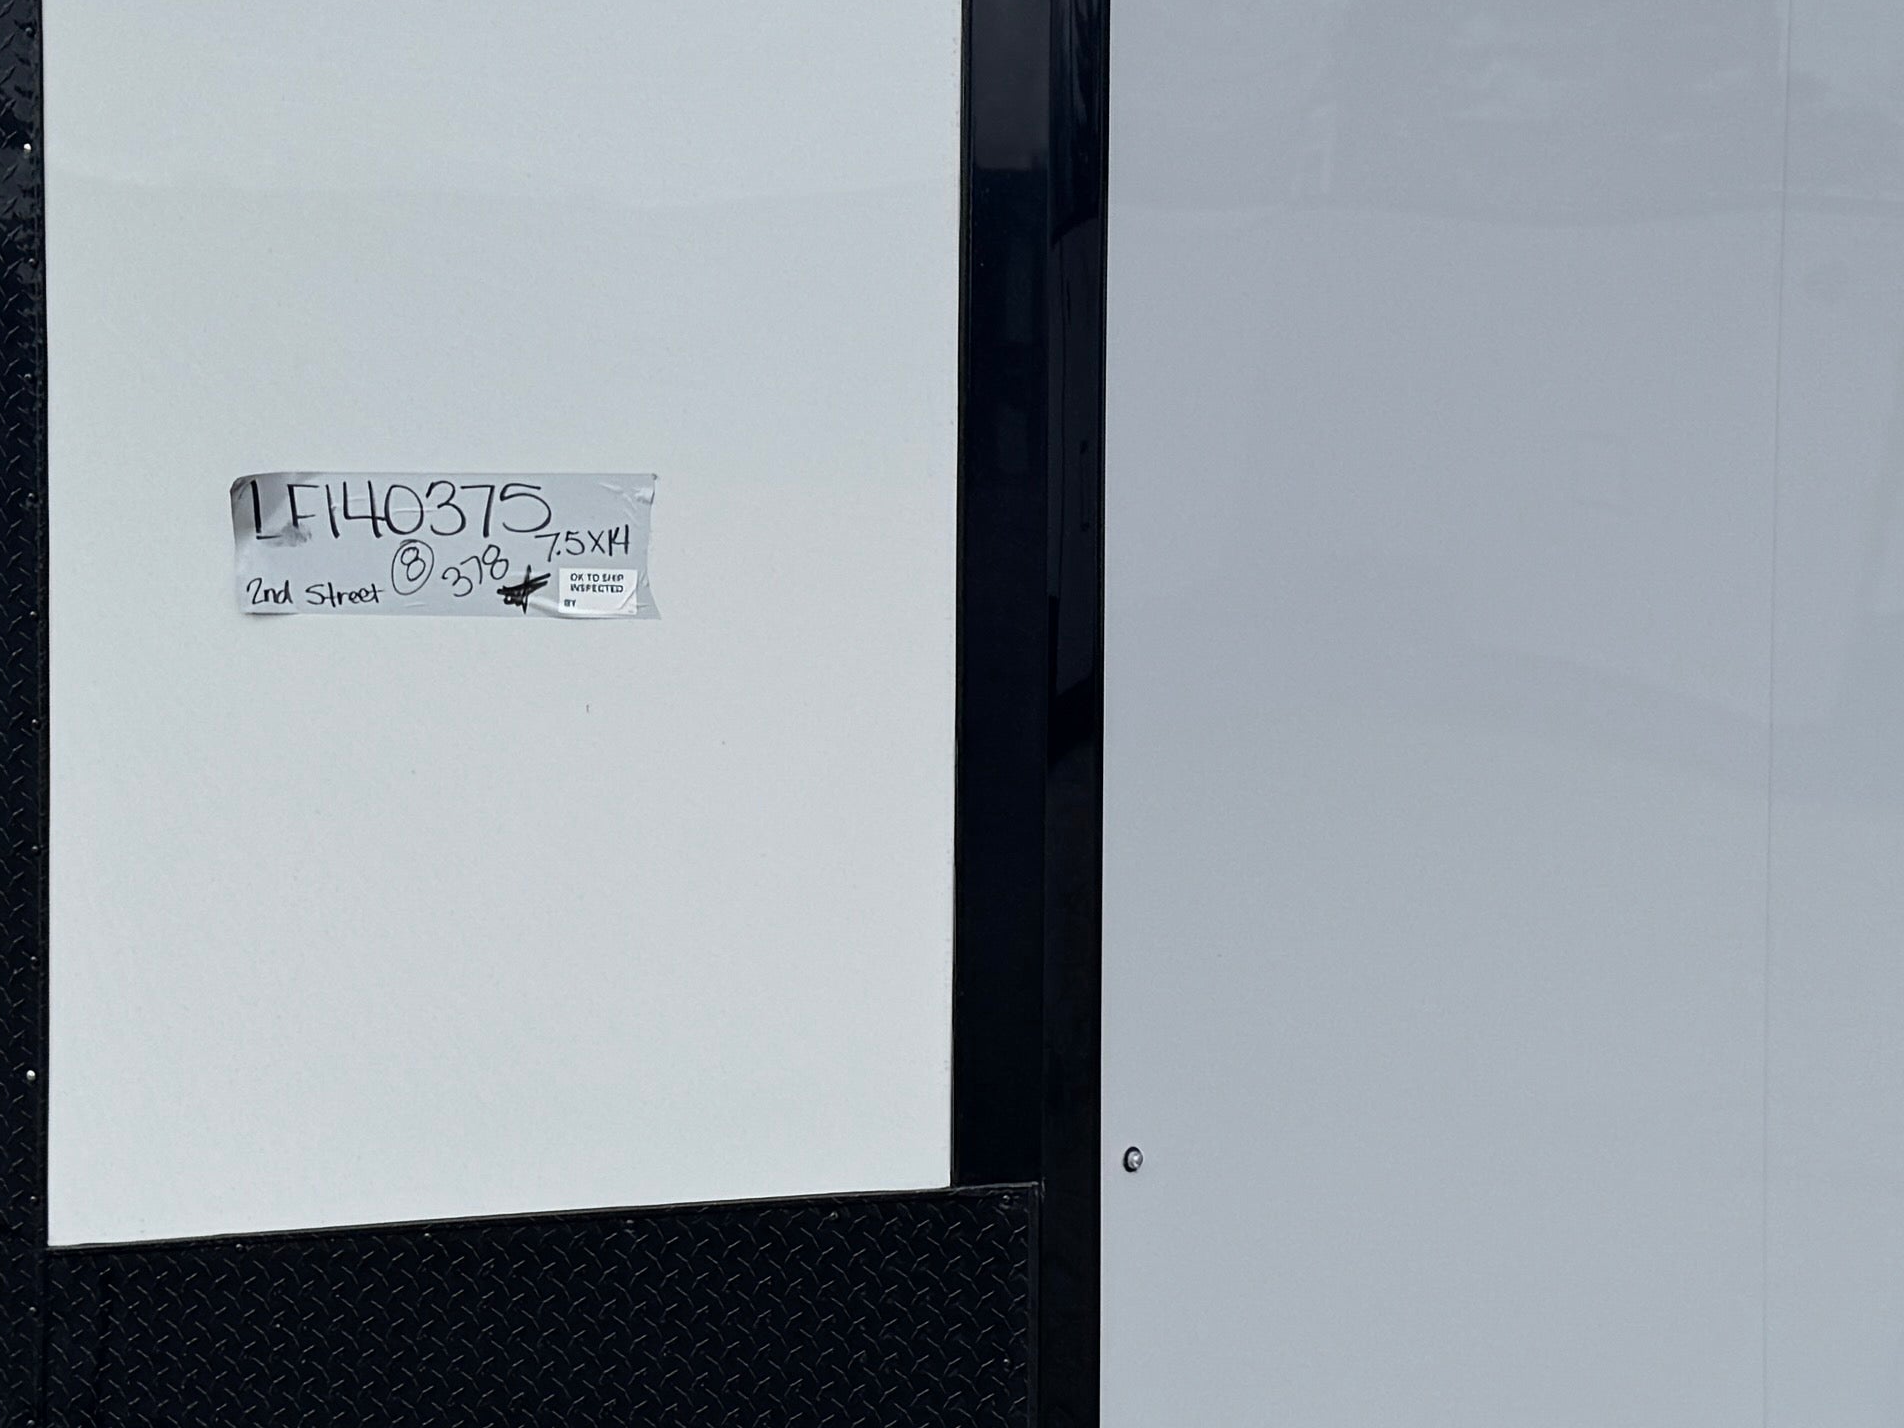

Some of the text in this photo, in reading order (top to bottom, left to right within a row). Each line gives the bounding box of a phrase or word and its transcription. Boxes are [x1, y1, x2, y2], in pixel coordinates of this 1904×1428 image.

[251, 479, 552, 540] LF140375
[441, 543, 510, 598] 378
[570, 572, 584, 582] OK
[587, 573, 600, 583] TO
[246, 577, 293, 606] 2nd
[570, 584, 625, 593] INSPECTED
